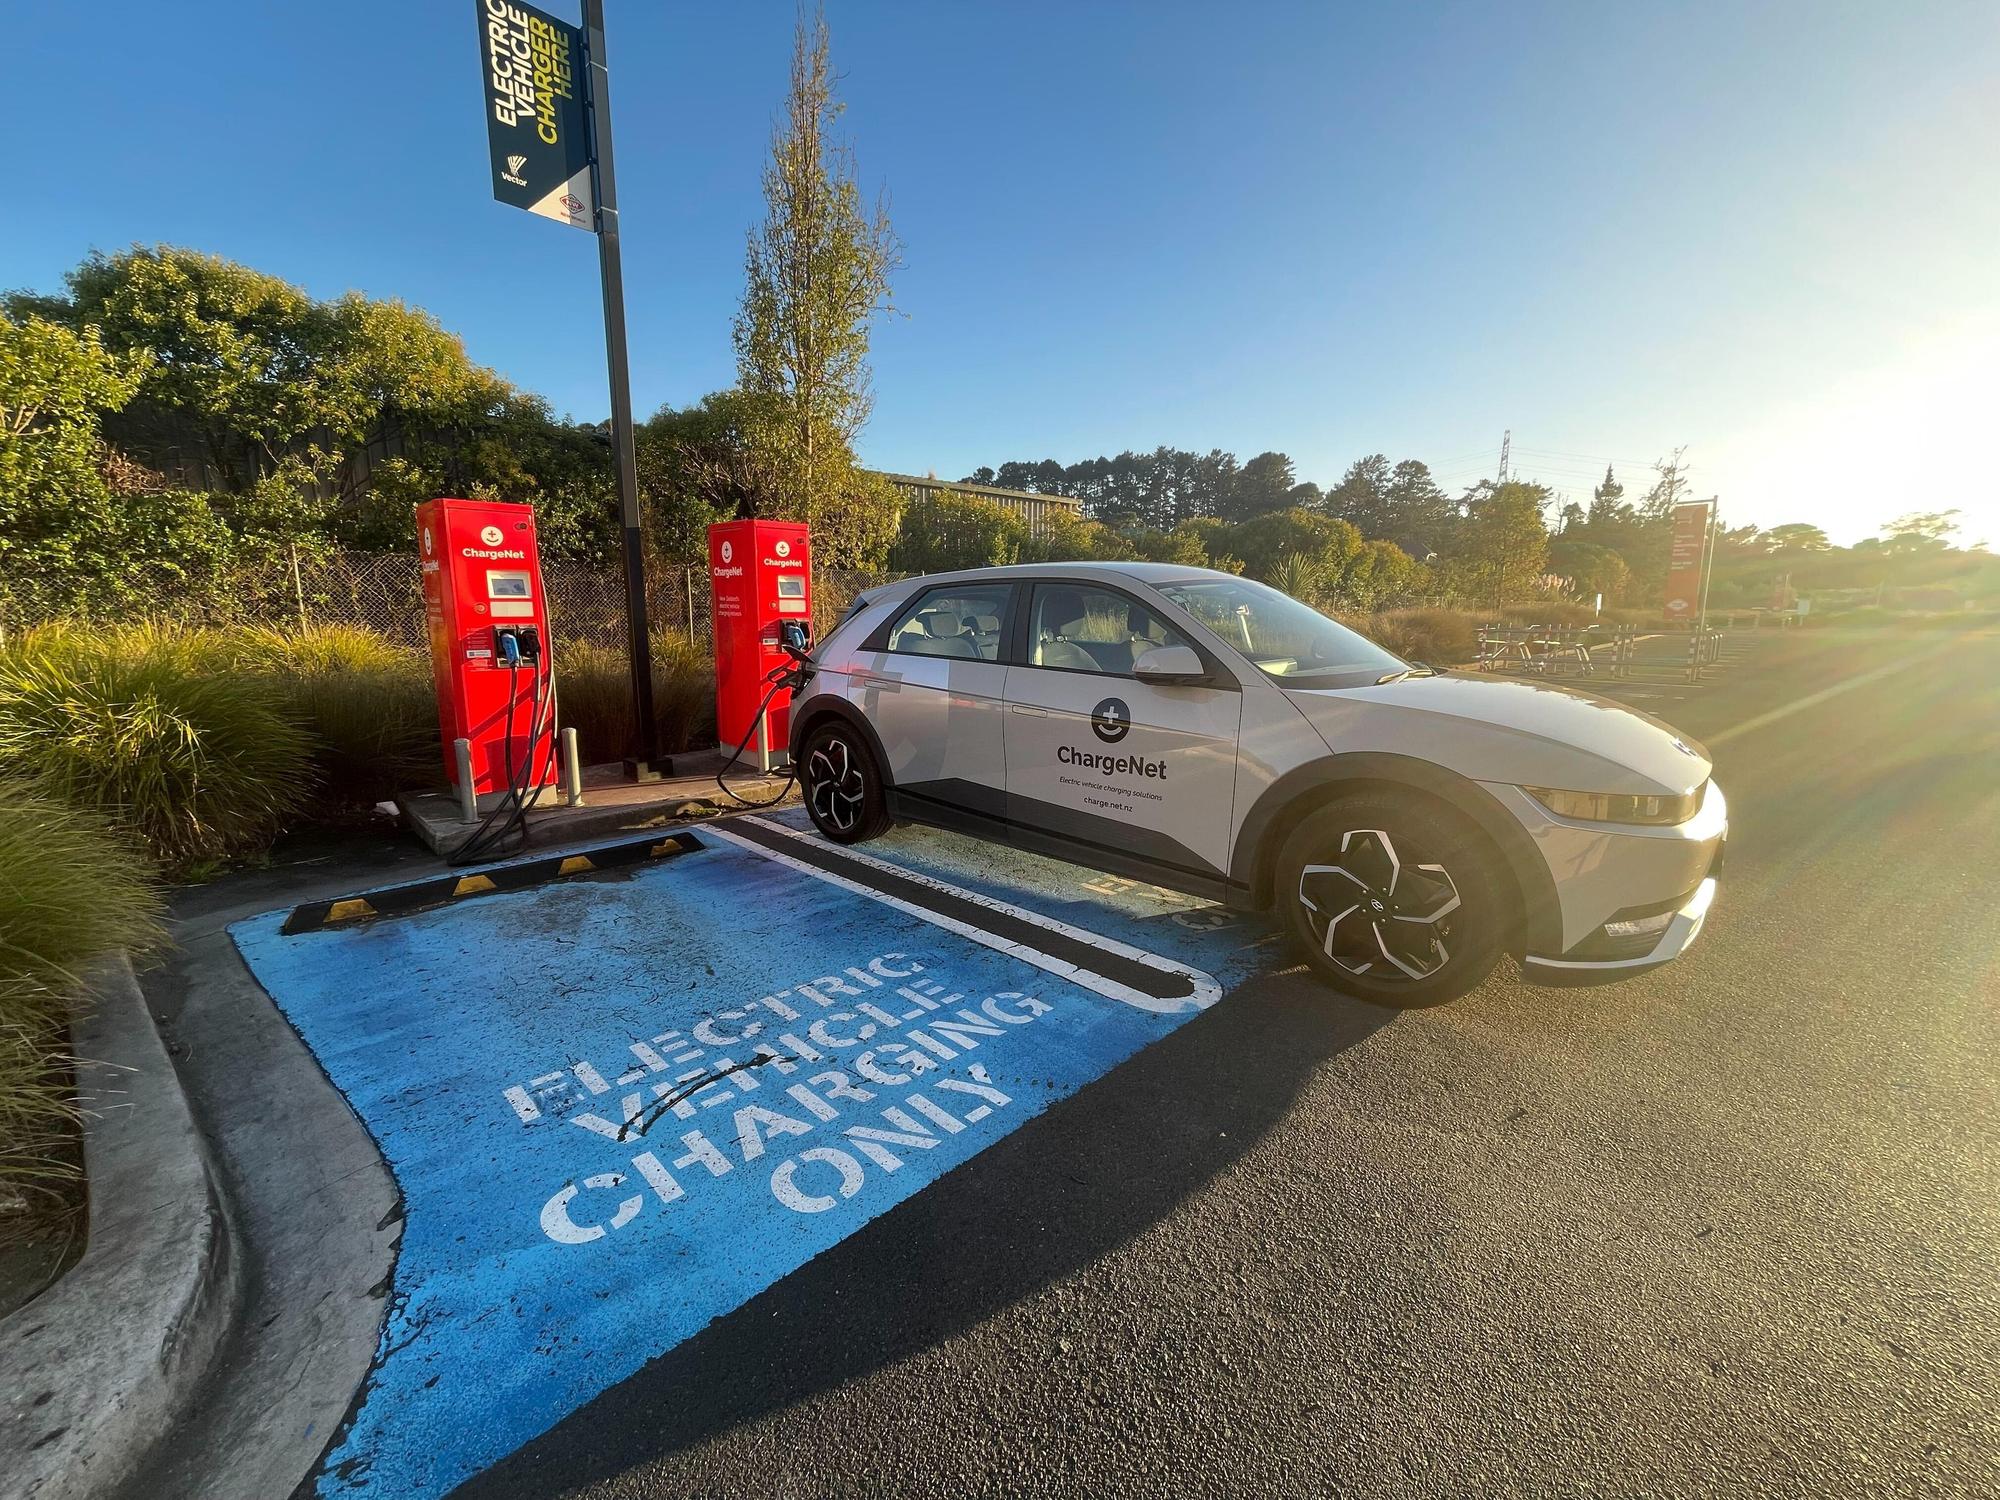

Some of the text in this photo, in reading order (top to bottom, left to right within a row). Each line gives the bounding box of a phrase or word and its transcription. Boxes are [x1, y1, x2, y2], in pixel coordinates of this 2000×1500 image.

[485, 0, 516, 127] ELECTRIC
[508, 4, 536, 116] VEHICLE
[529, 16, 558, 145] CHARGER
[549, 25, 573, 99] HERE
[501, 172, 527, 187] Vector
[462, 547, 525, 561] ChargeNet
[714, 566, 743, 579] ChargeNet
[763, 558, 802, 568] ChargeNet
[1057, 746, 1167, 780] ChargeNet
[1059, 776, 1162, 801] Electric vehicle charging solutions
[1083, 796, 1133, 812] charge.net.nz
[503, 953, 924, 1123] ELECTRIC
[570, 979, 964, 1144] VEHICLE
[540, 992, 1054, 1245] CHARGING
[770, 1063, 1013, 1214] ONLY
